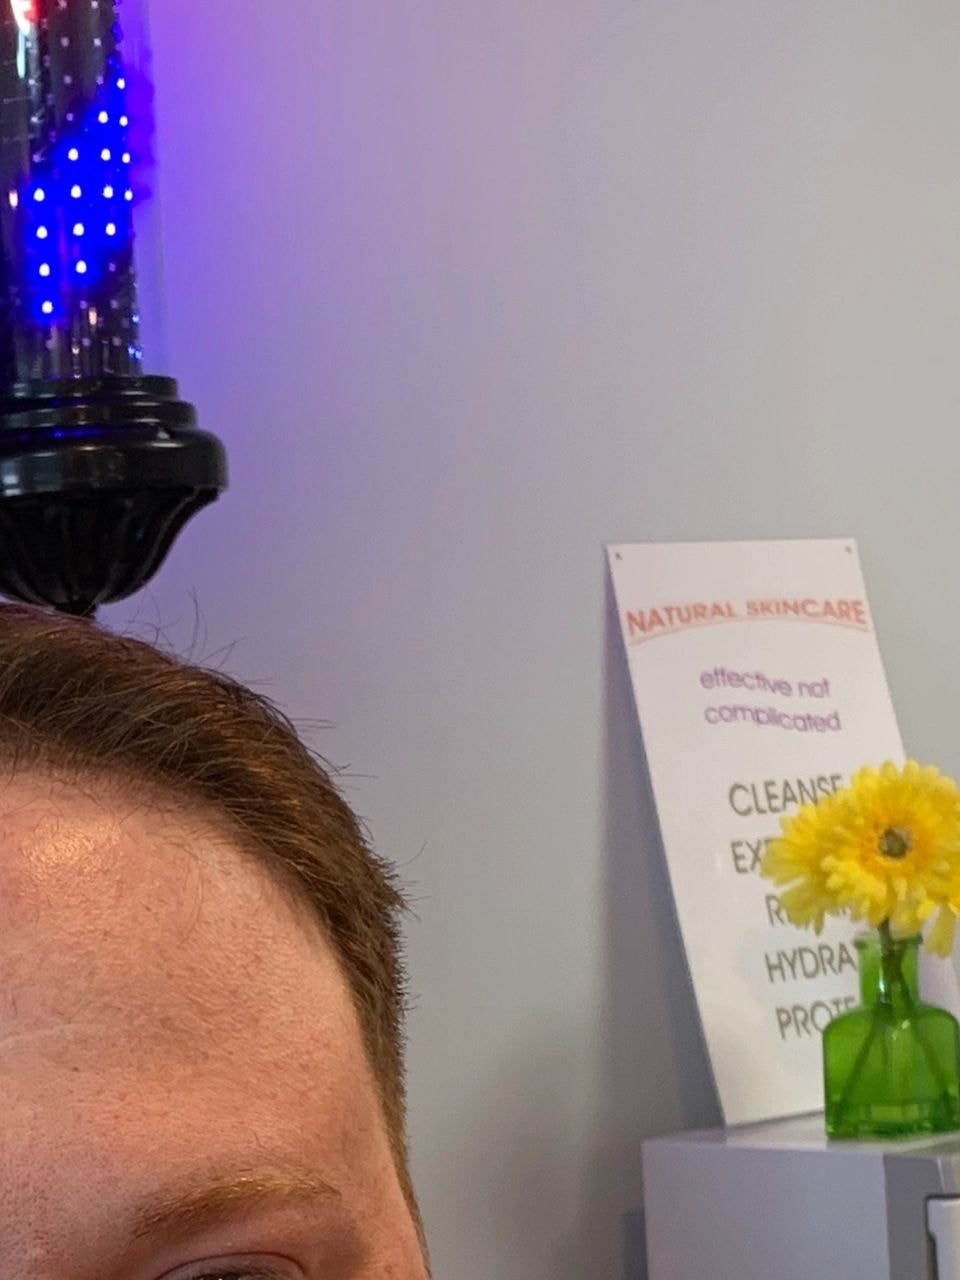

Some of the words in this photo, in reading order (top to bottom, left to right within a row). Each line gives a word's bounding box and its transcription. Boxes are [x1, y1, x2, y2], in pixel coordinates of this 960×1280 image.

[626, 602, 738, 636] NATURAL
[746, 599, 868, 625] SKINCARE
[699, 666, 793, 697] effective
[798, 677, 830, 698] not
[704, 704, 842, 733] complicated
[764, 942, 857, 983] HYDRA
[775, 996, 857, 1040] PRO
